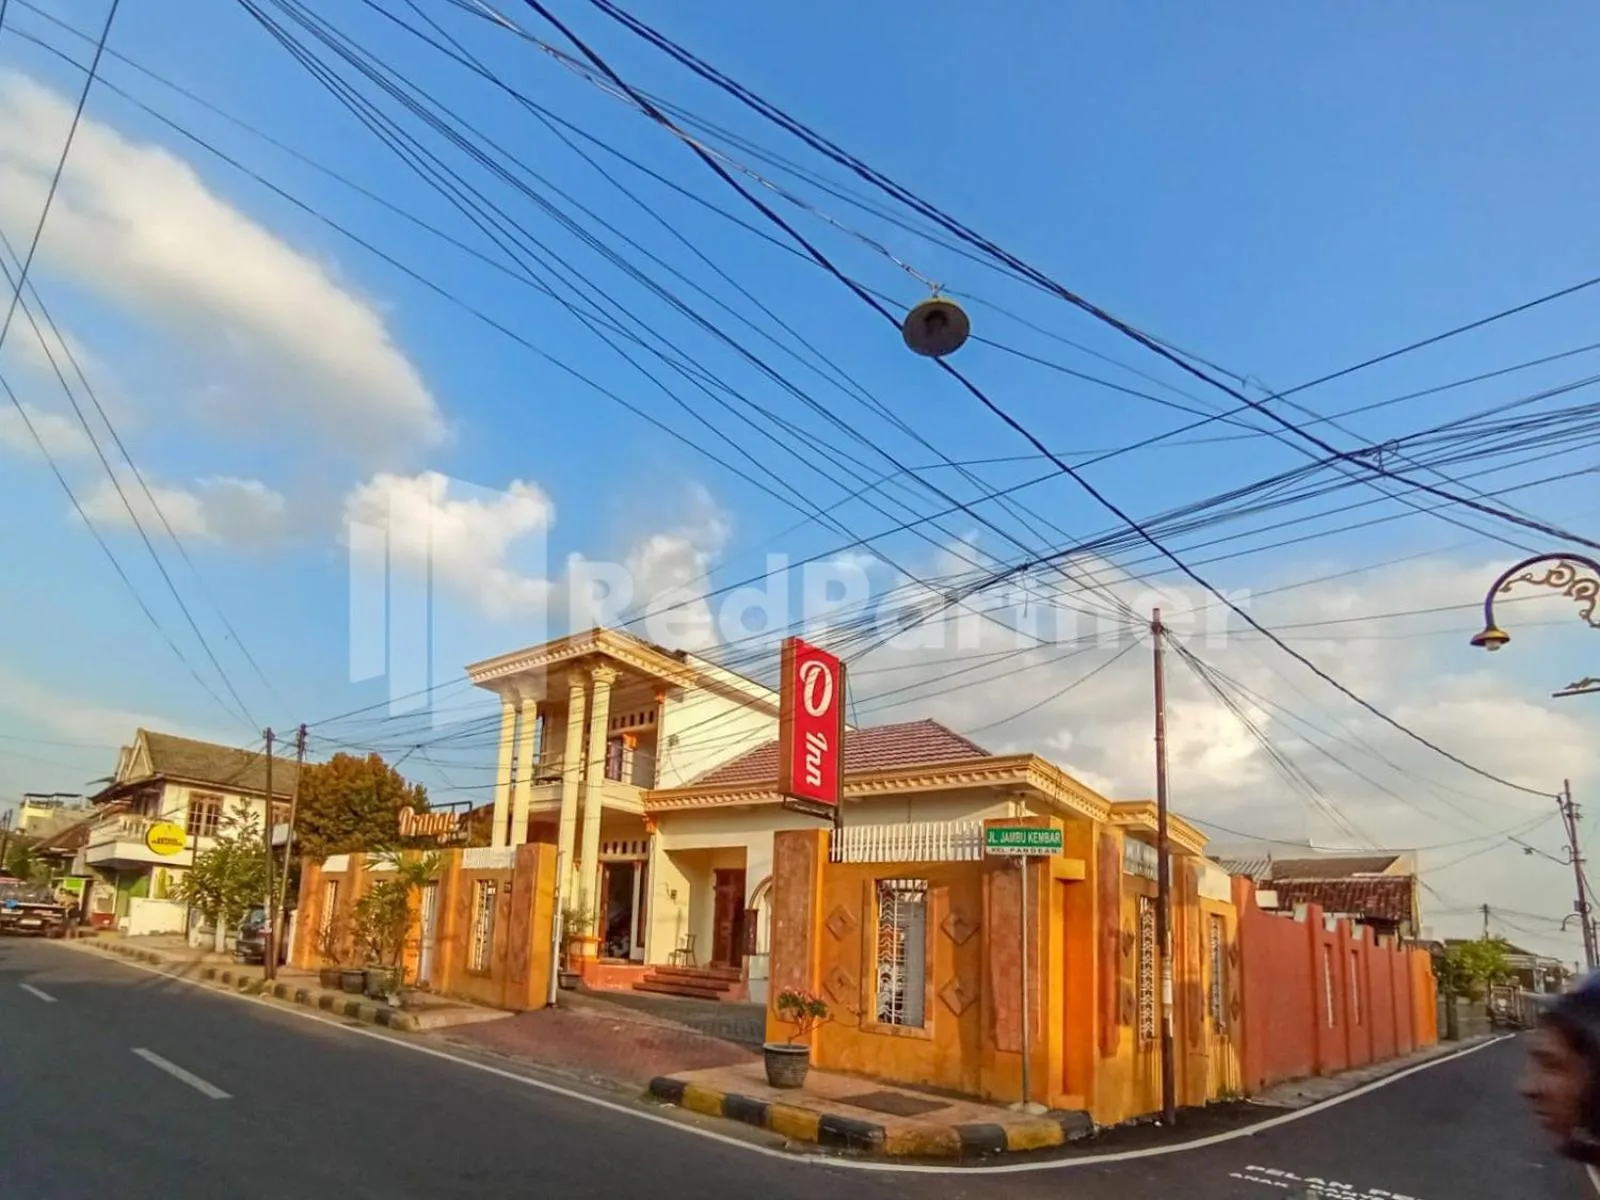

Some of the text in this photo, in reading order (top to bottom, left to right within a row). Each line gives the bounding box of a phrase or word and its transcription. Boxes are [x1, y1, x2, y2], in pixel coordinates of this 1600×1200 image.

[800, 660, 833, 787] O Inn
[1000, 831, 1027, 844] JAMBU
[1028, 831, 1061, 844] KEMBAR
[1228, 1172, 1289, 1188] ANAK
[1244, 1164, 1354, 1190] PELAN
